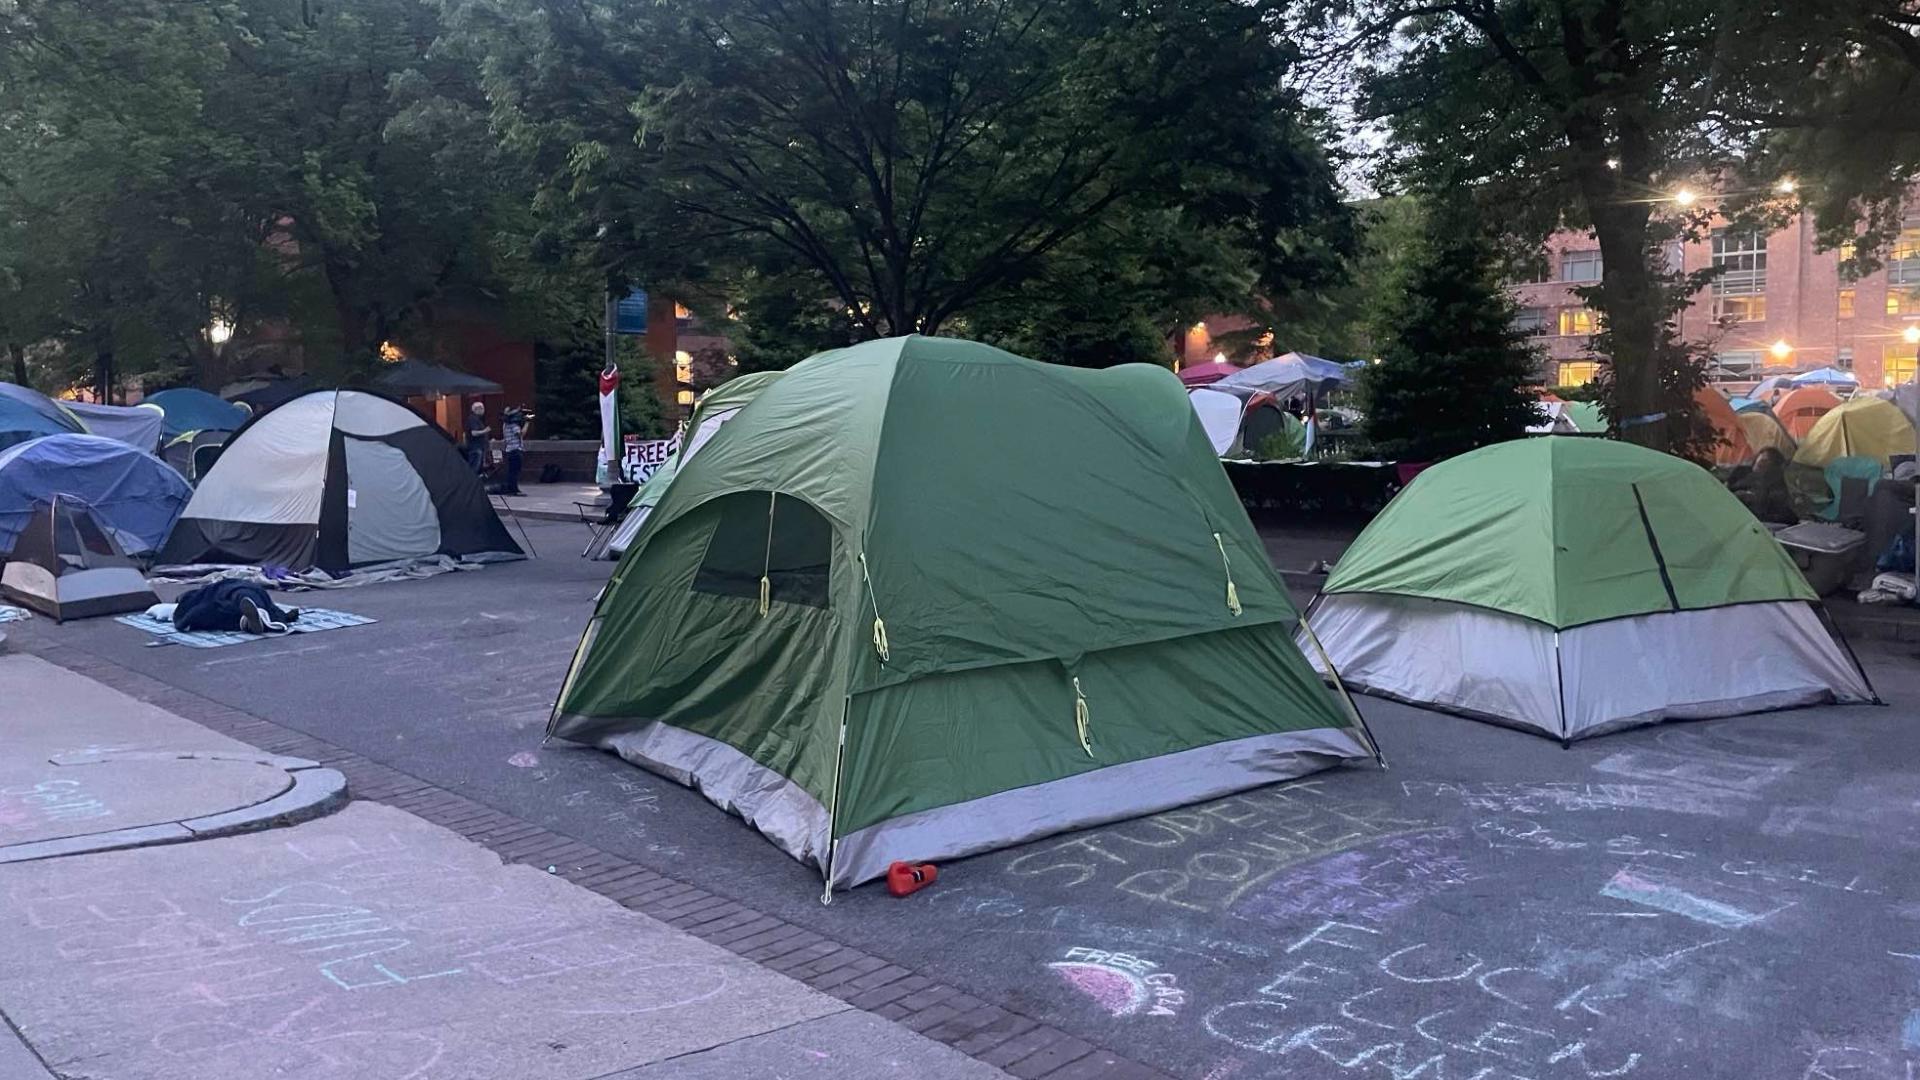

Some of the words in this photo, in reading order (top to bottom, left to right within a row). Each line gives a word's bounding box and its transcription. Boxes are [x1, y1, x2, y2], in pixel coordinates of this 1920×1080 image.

[627, 442, 664, 463] FREE
[630, 463, 663, 483] EST
[1007, 780, 1325, 887] STUDENT
[1115, 803, 1428, 913] POWER
[1065, 946, 1159, 976] FREE
[1144, 973, 1186, 1016] GAZA
